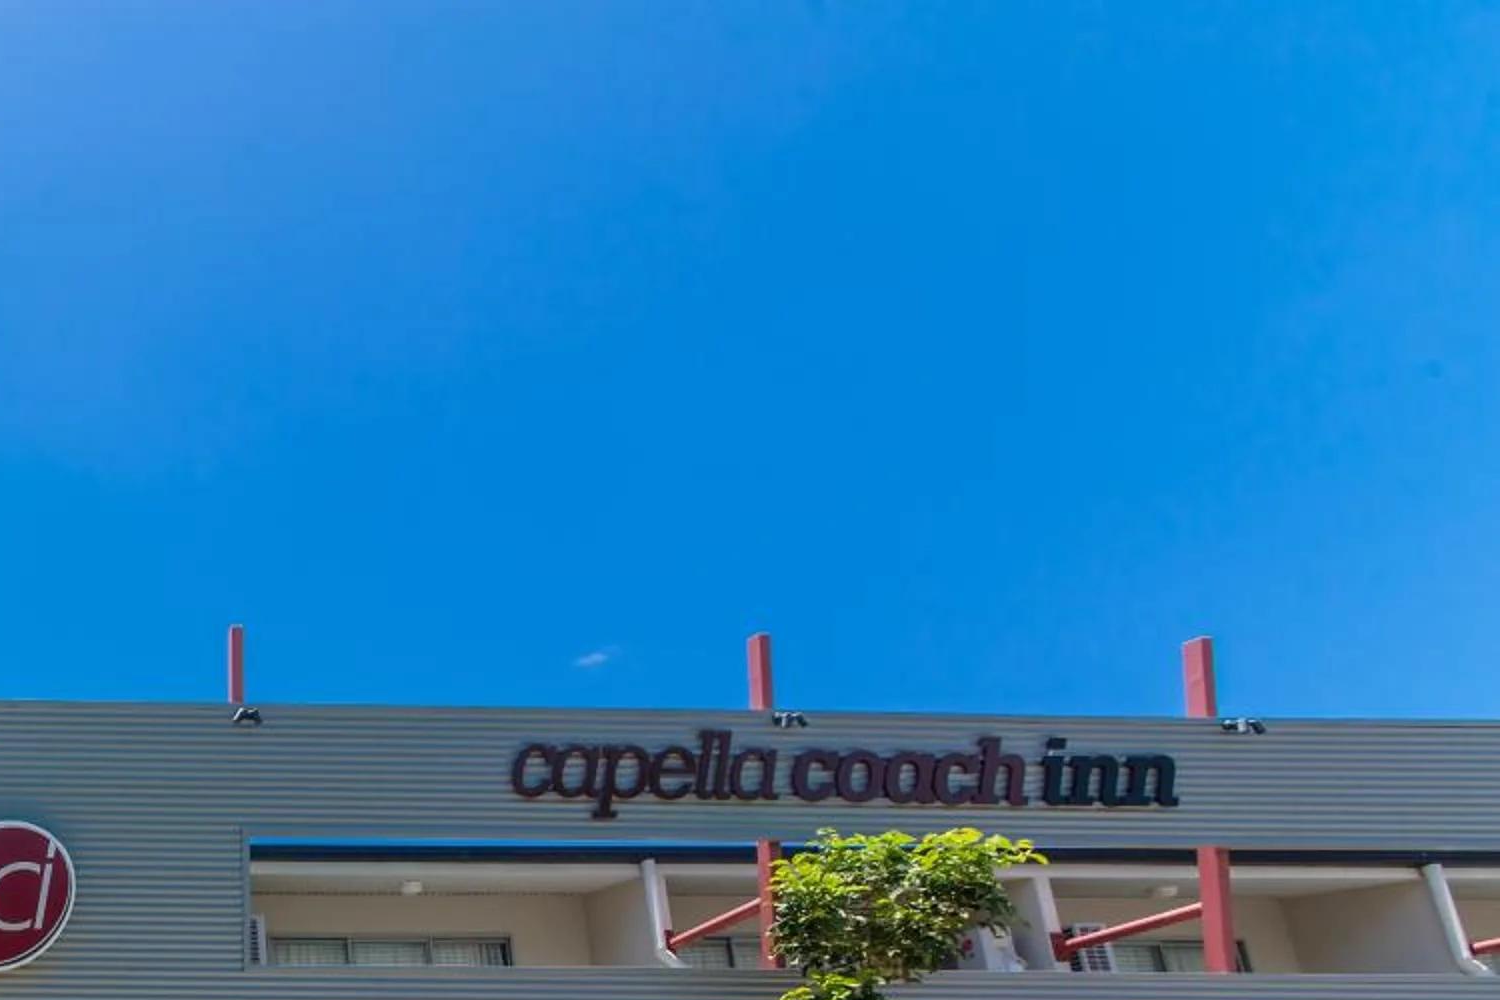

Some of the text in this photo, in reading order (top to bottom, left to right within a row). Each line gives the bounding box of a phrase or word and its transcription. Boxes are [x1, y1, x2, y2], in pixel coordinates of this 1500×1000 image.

[509, 728, 1180, 820] capella coach inn
